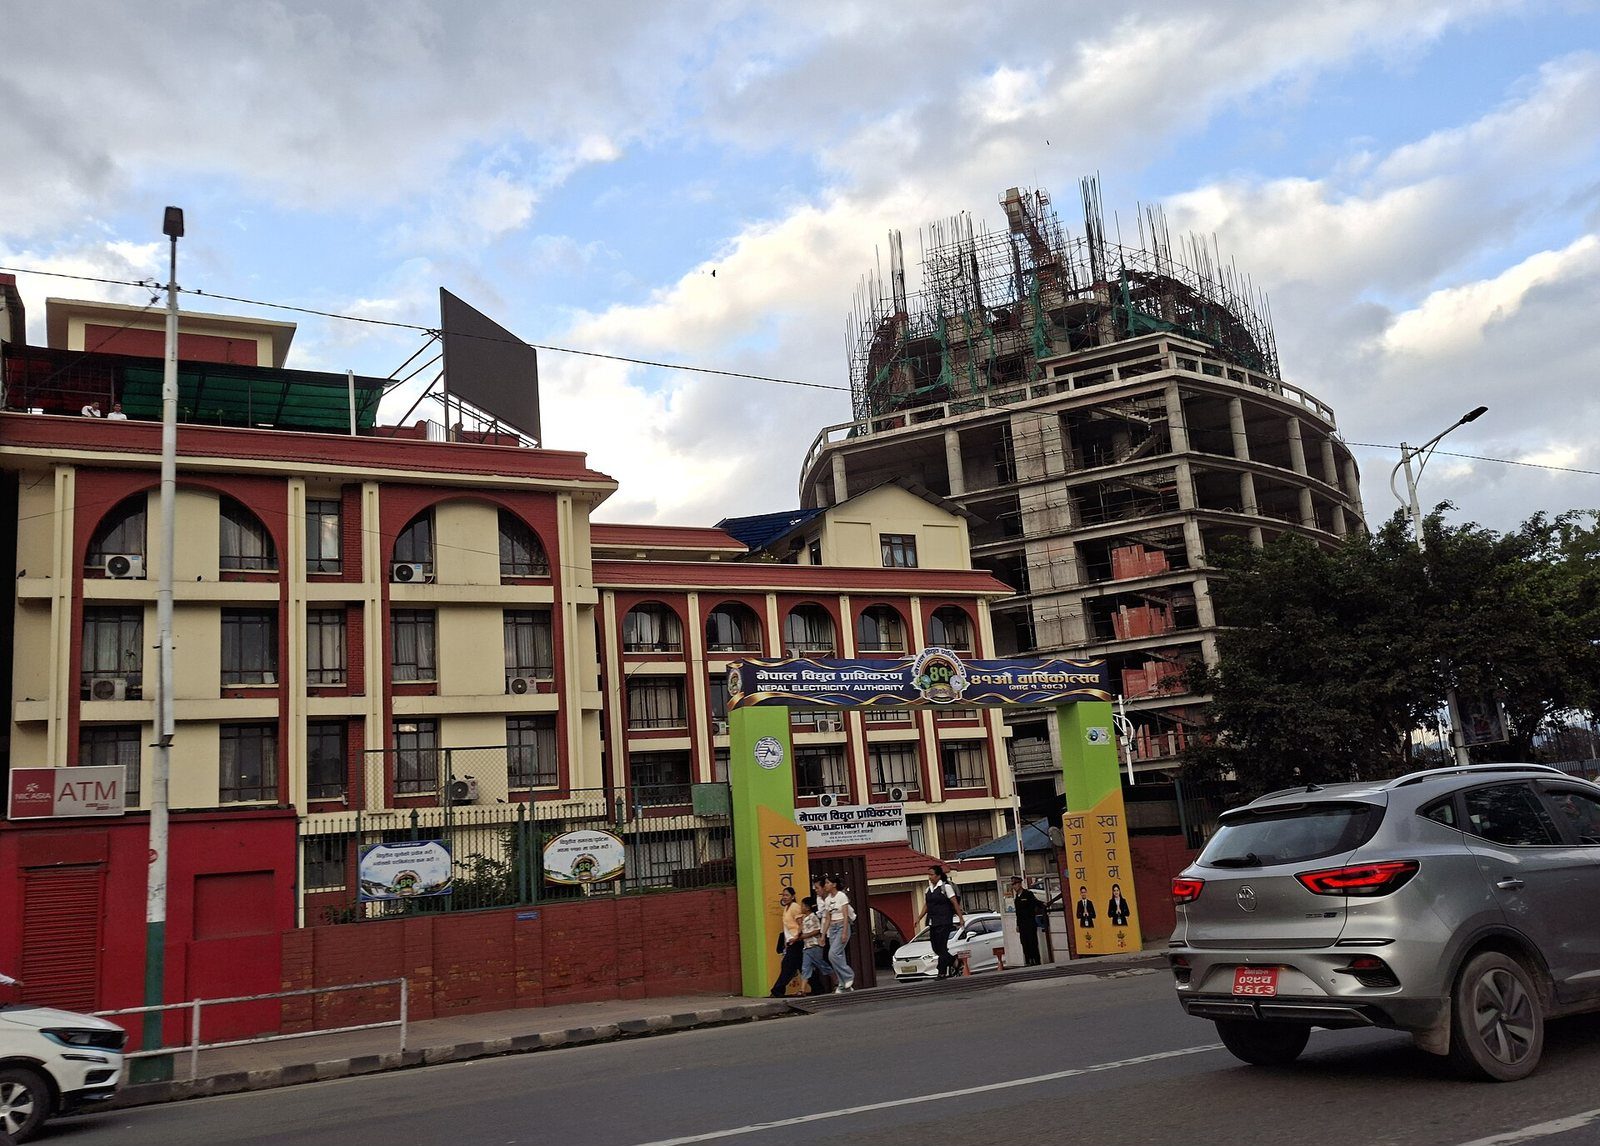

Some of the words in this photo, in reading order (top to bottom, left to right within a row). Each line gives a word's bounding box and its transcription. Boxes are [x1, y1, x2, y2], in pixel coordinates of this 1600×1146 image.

[756, 670, 798, 681] नेपाल
[801, 669, 836, 682] विद्युत
[840, 670, 903, 682] प्राधिकरण
[1017, 671, 1100, 684] वार्षिकोत्सव
[57, 781, 117, 802] ATM
[799, 811, 828, 822] नेपाल
[829, 809, 855, 822] विद्युत
[856, 807, 902, 819] प्राधिकरण
[823, 821, 865, 831] ELECTRICITY
[866, 819, 903, 828] AUTHORITY
